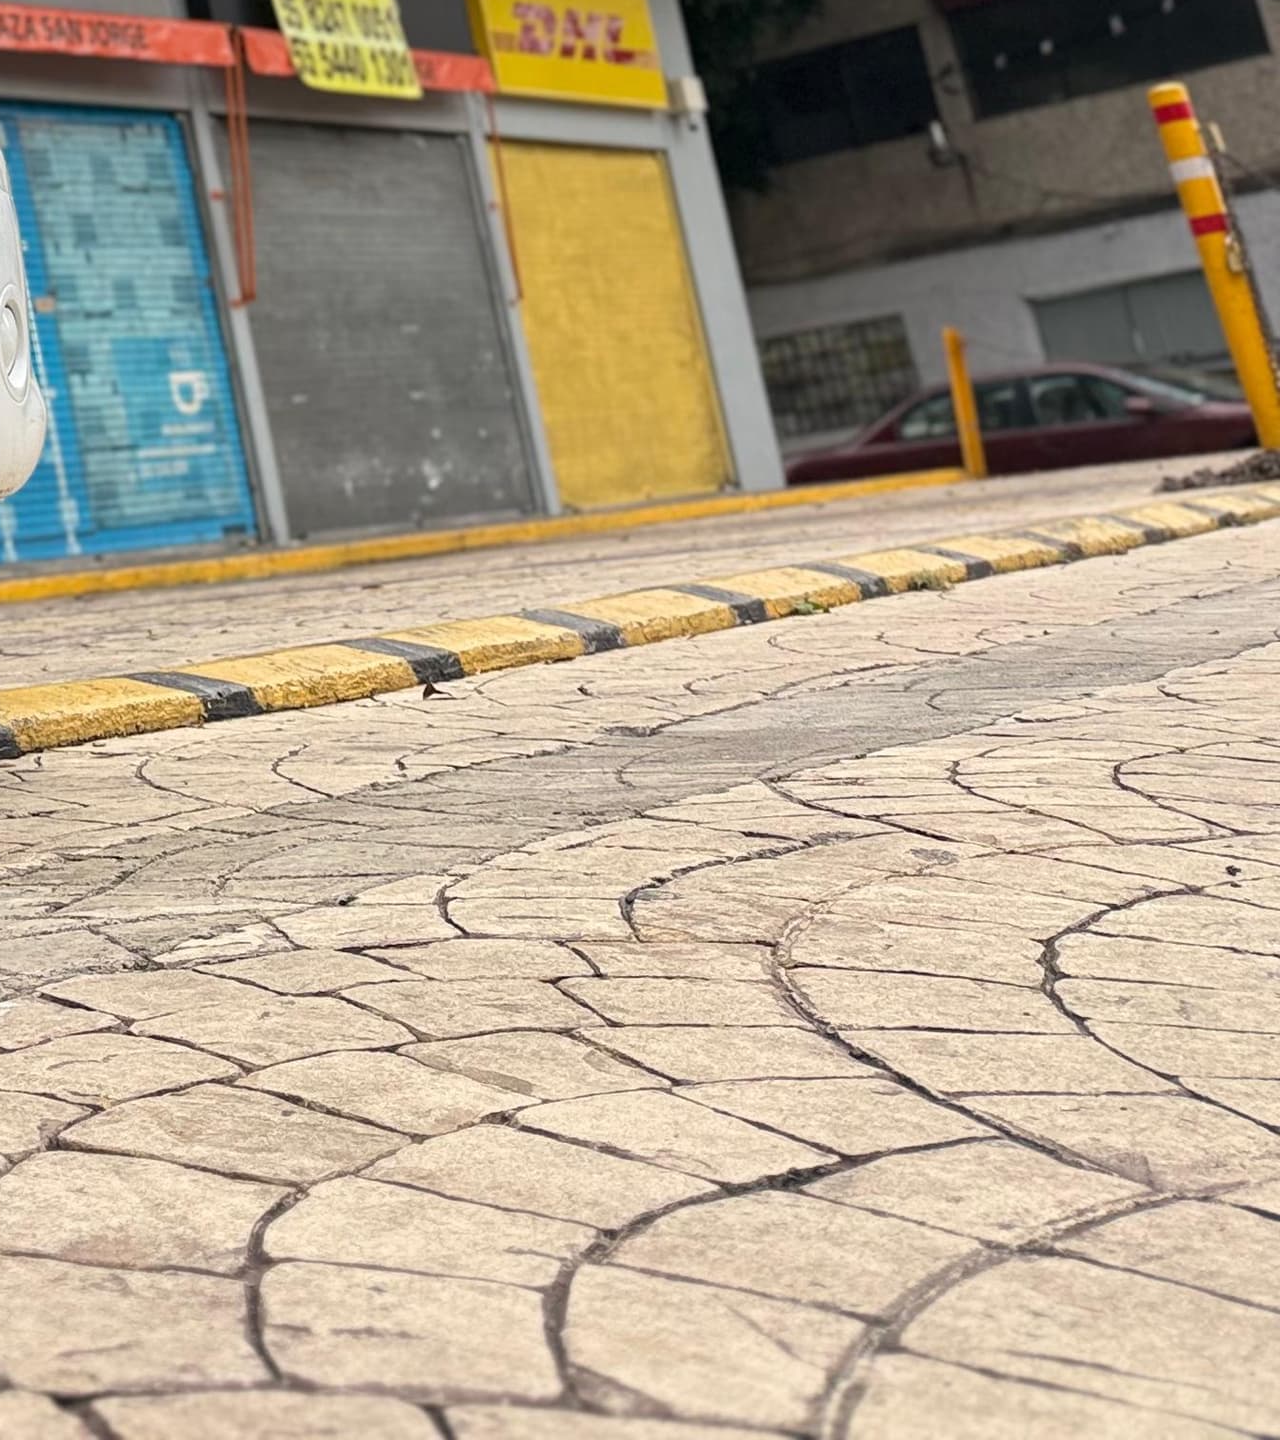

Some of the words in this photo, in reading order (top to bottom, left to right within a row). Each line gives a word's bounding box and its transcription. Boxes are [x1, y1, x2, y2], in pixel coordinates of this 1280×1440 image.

[41, 15, 83, 45] SAN
[88, 18, 148, 50] JORGE
[512, 0, 636, 64] DHL
